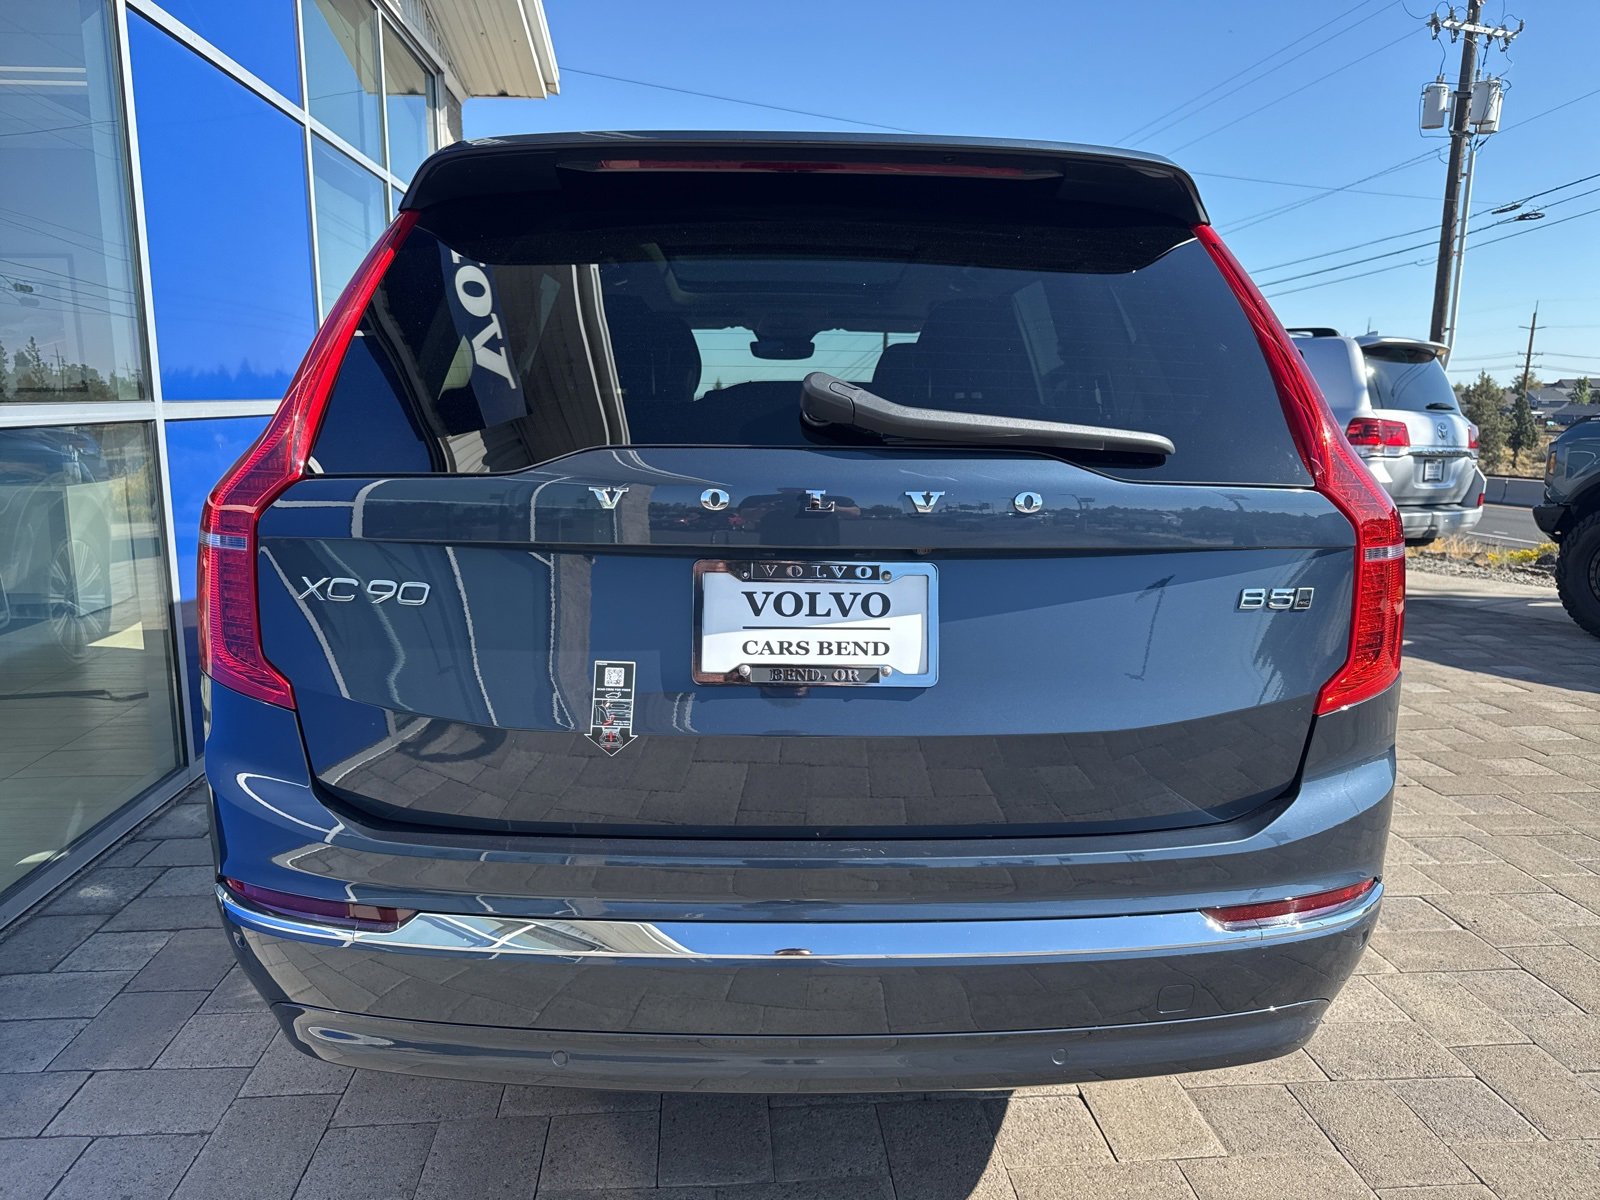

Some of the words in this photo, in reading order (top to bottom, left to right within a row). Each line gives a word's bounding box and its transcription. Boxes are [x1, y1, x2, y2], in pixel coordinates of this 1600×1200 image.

[588, 486, 1044, 514] VOLVO
[760, 564, 873, 579] VOLVO
[741, 590, 892, 618] VOLVO
[741, 640, 810, 656] CARS
[816, 640, 891, 657] BEND
[769, 668, 827, 682] BEND,
[831, 668, 860, 682] OR
